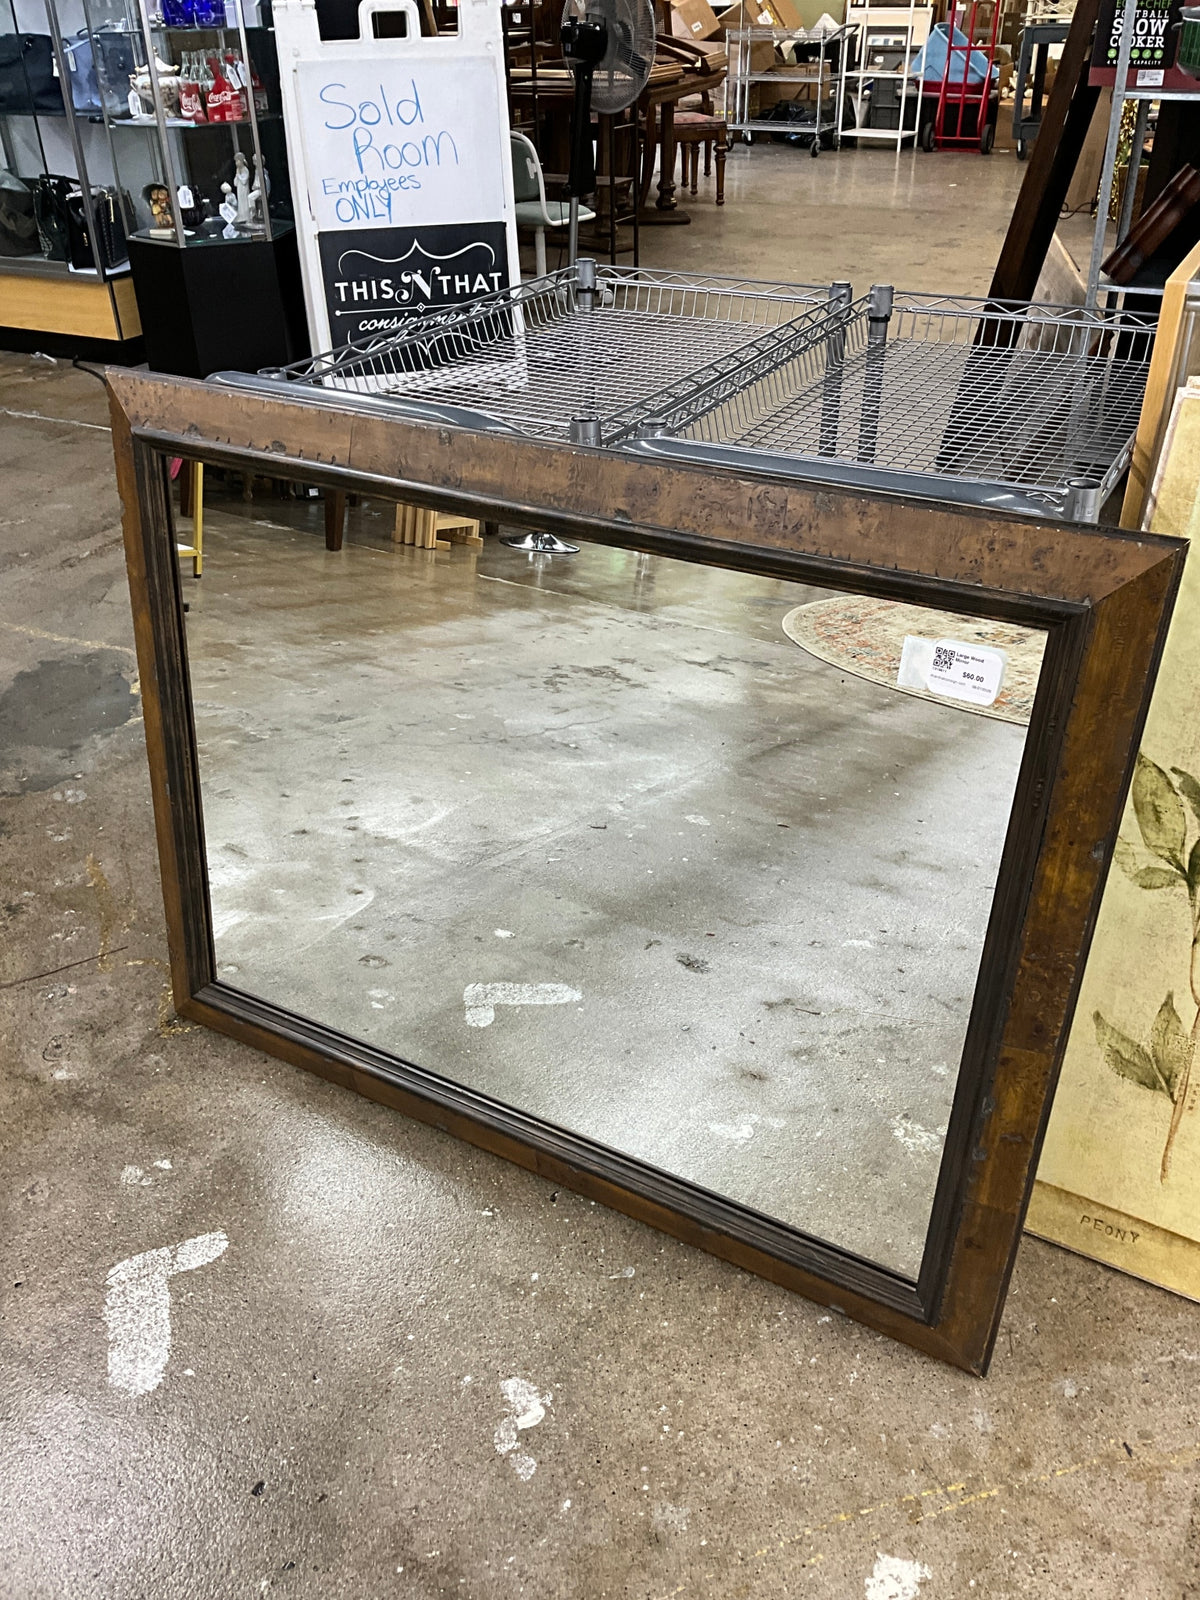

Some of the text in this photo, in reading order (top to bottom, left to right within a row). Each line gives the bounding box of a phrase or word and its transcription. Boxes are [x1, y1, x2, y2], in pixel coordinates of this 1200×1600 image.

[1112, 18, 1169, 35] SOW
[319, 79, 424, 130] Sold
[353, 127, 459, 174] Room
[335, 192, 392, 224] ONLY
[334, 266, 502, 304] THIS N THAT
[962, 672, 984, 682] $60.00
[1080, 1215, 1140, 1243] PEONY
